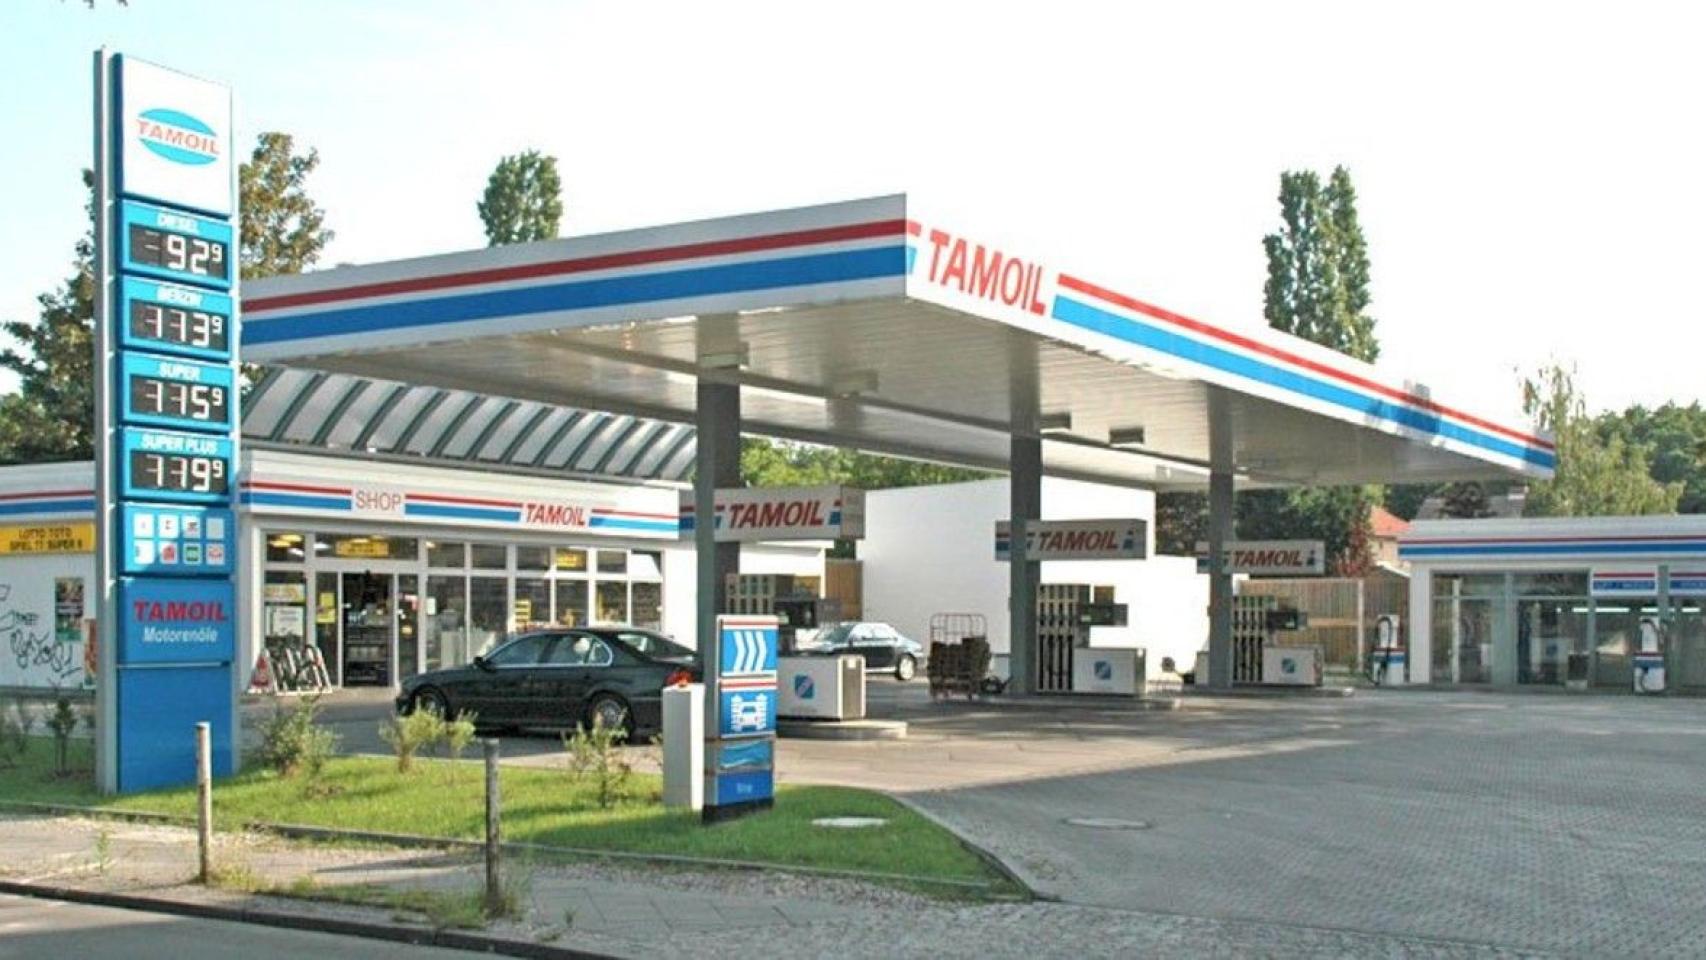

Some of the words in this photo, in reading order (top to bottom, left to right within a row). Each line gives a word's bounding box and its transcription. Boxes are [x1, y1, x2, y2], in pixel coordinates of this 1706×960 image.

[135, 119, 220, 154] TAMOIL
[930, 229, 1046, 316] TAMOIL
[159, 361, 200, 381] SUPER
[140, 434, 183, 453] SUPER
[185, 438, 218, 455] PLUS
[356, 491, 401, 510] SHOP
[526, 503, 585, 526] TAMOIL
[729, 500, 824, 529] TAMOIL
[1038, 531, 1119, 551] TAMOIL
[1233, 550, 1302, 567] TAMOIL
[133, 601, 228, 622] TAMOIL
